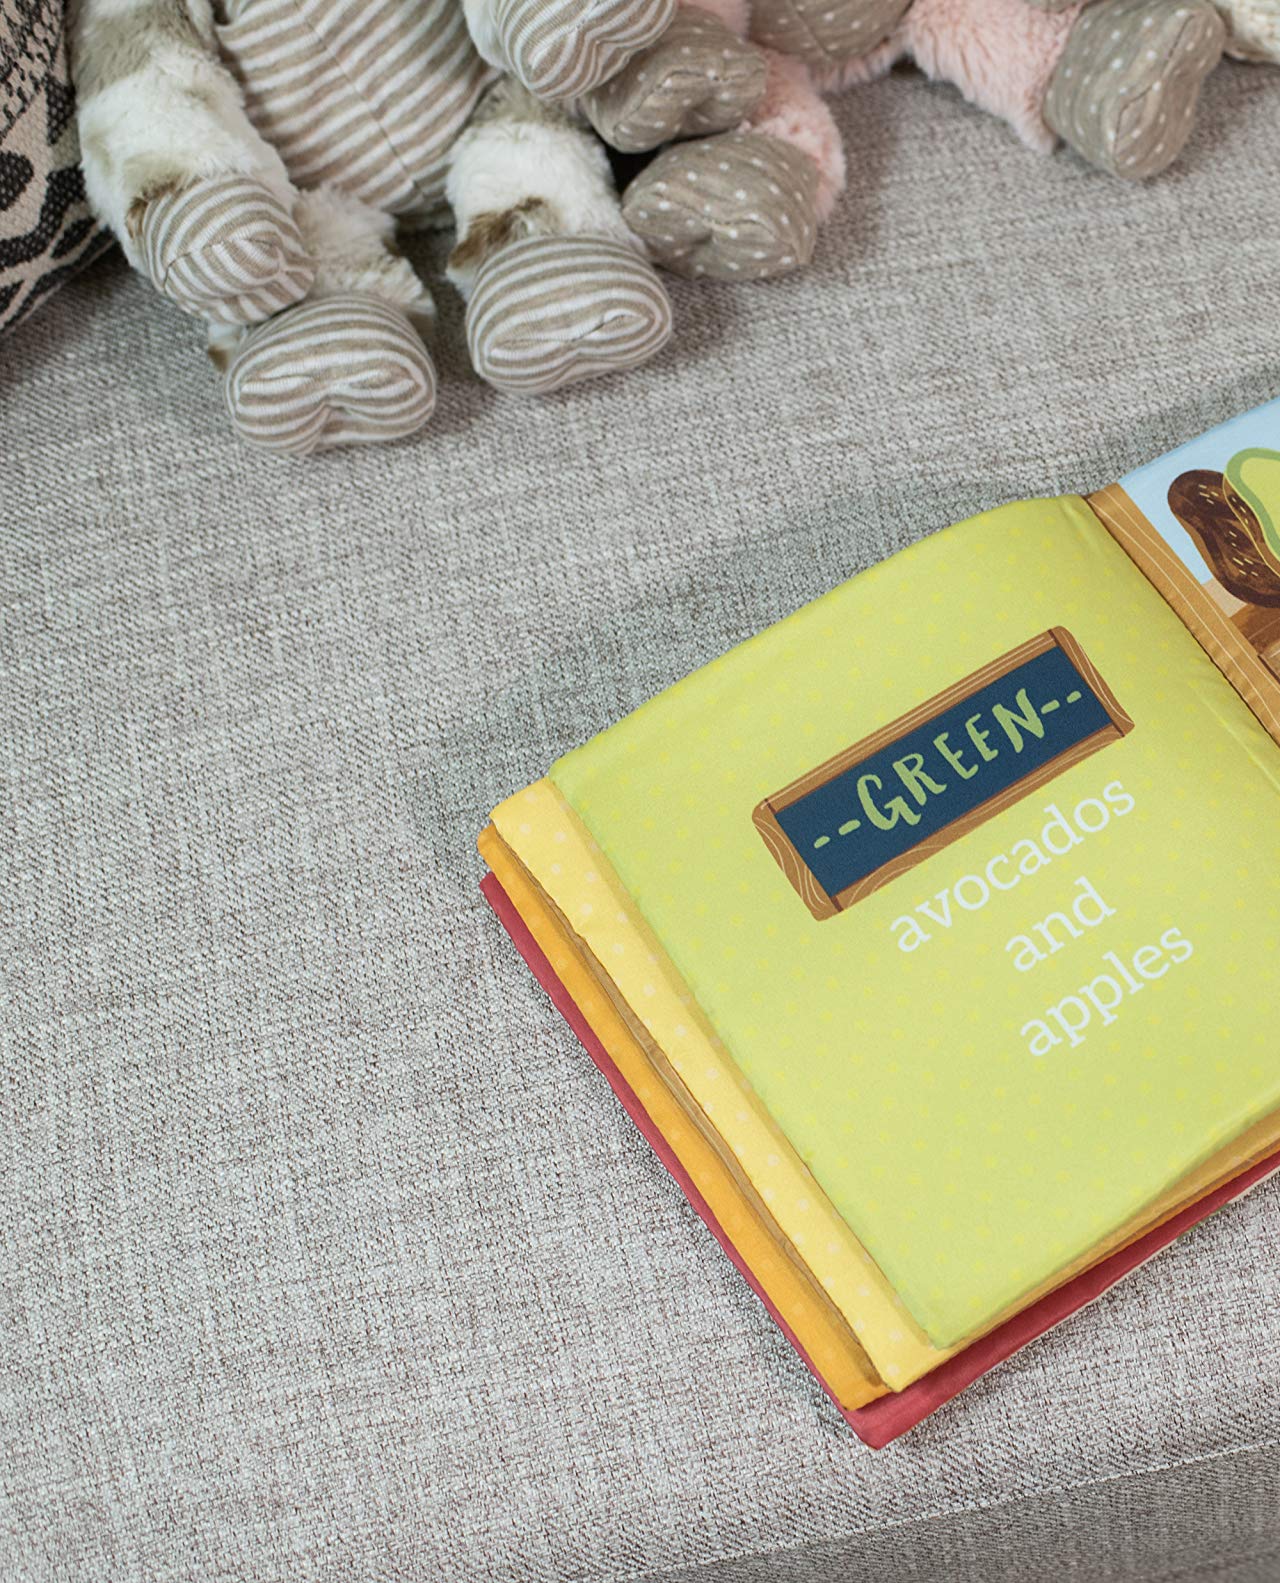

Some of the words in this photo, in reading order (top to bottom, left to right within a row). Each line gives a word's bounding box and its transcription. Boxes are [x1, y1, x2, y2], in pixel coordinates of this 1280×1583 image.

[856, 687, 1046, 831] GREEN
[888, 779, 1136, 953] avocados
[1004, 876, 1117, 973] and
[1019, 926, 1194, 1057] apples
